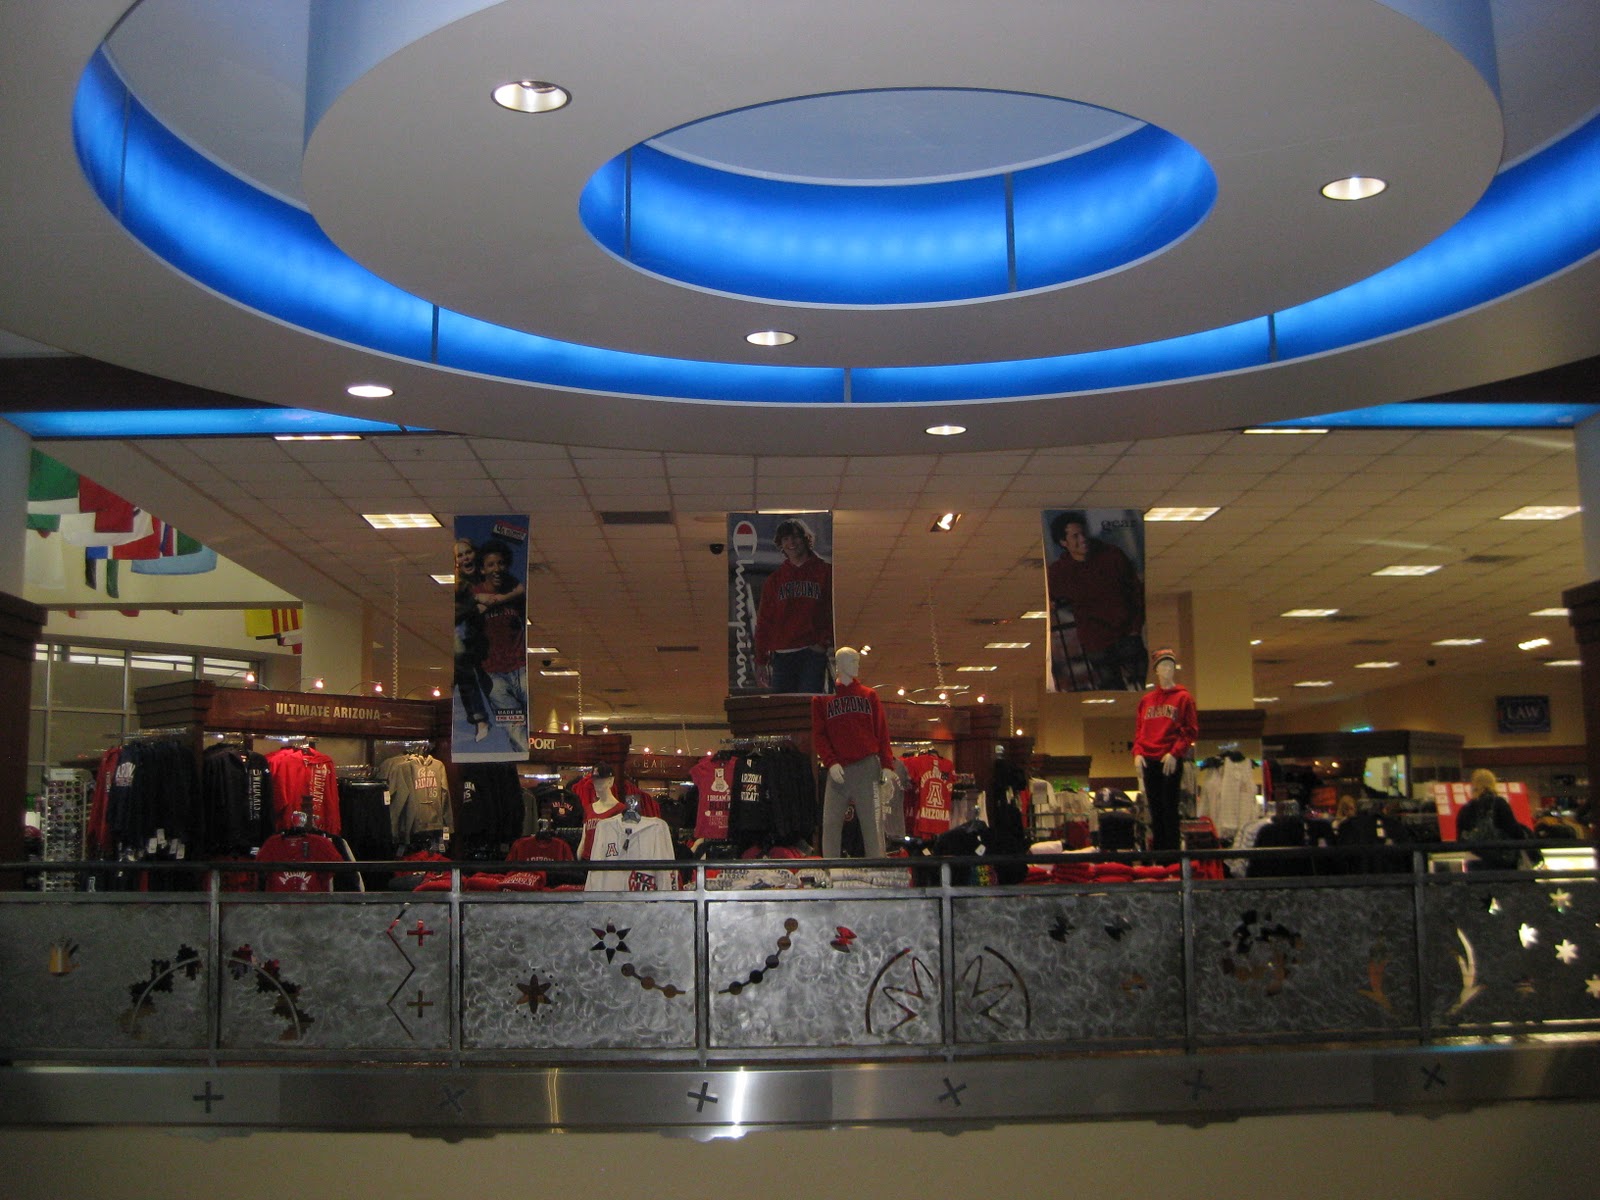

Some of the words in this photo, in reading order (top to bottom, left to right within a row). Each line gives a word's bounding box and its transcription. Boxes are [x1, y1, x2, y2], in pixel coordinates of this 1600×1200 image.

[777, 580, 822, 600] ARIZONA
[728, 520, 758, 689] Champion
[276, 703, 330, 717] ULTIMATE
[333, 706, 381, 720] ARIZONA
[827, 696, 872, 720] ARIZONA
[1506, 704, 1541, 720] LAW
[926, 782, 945, 808] A
[920, 807, 950, 821] ARIZONA
[606, 842, 619, 857] A
